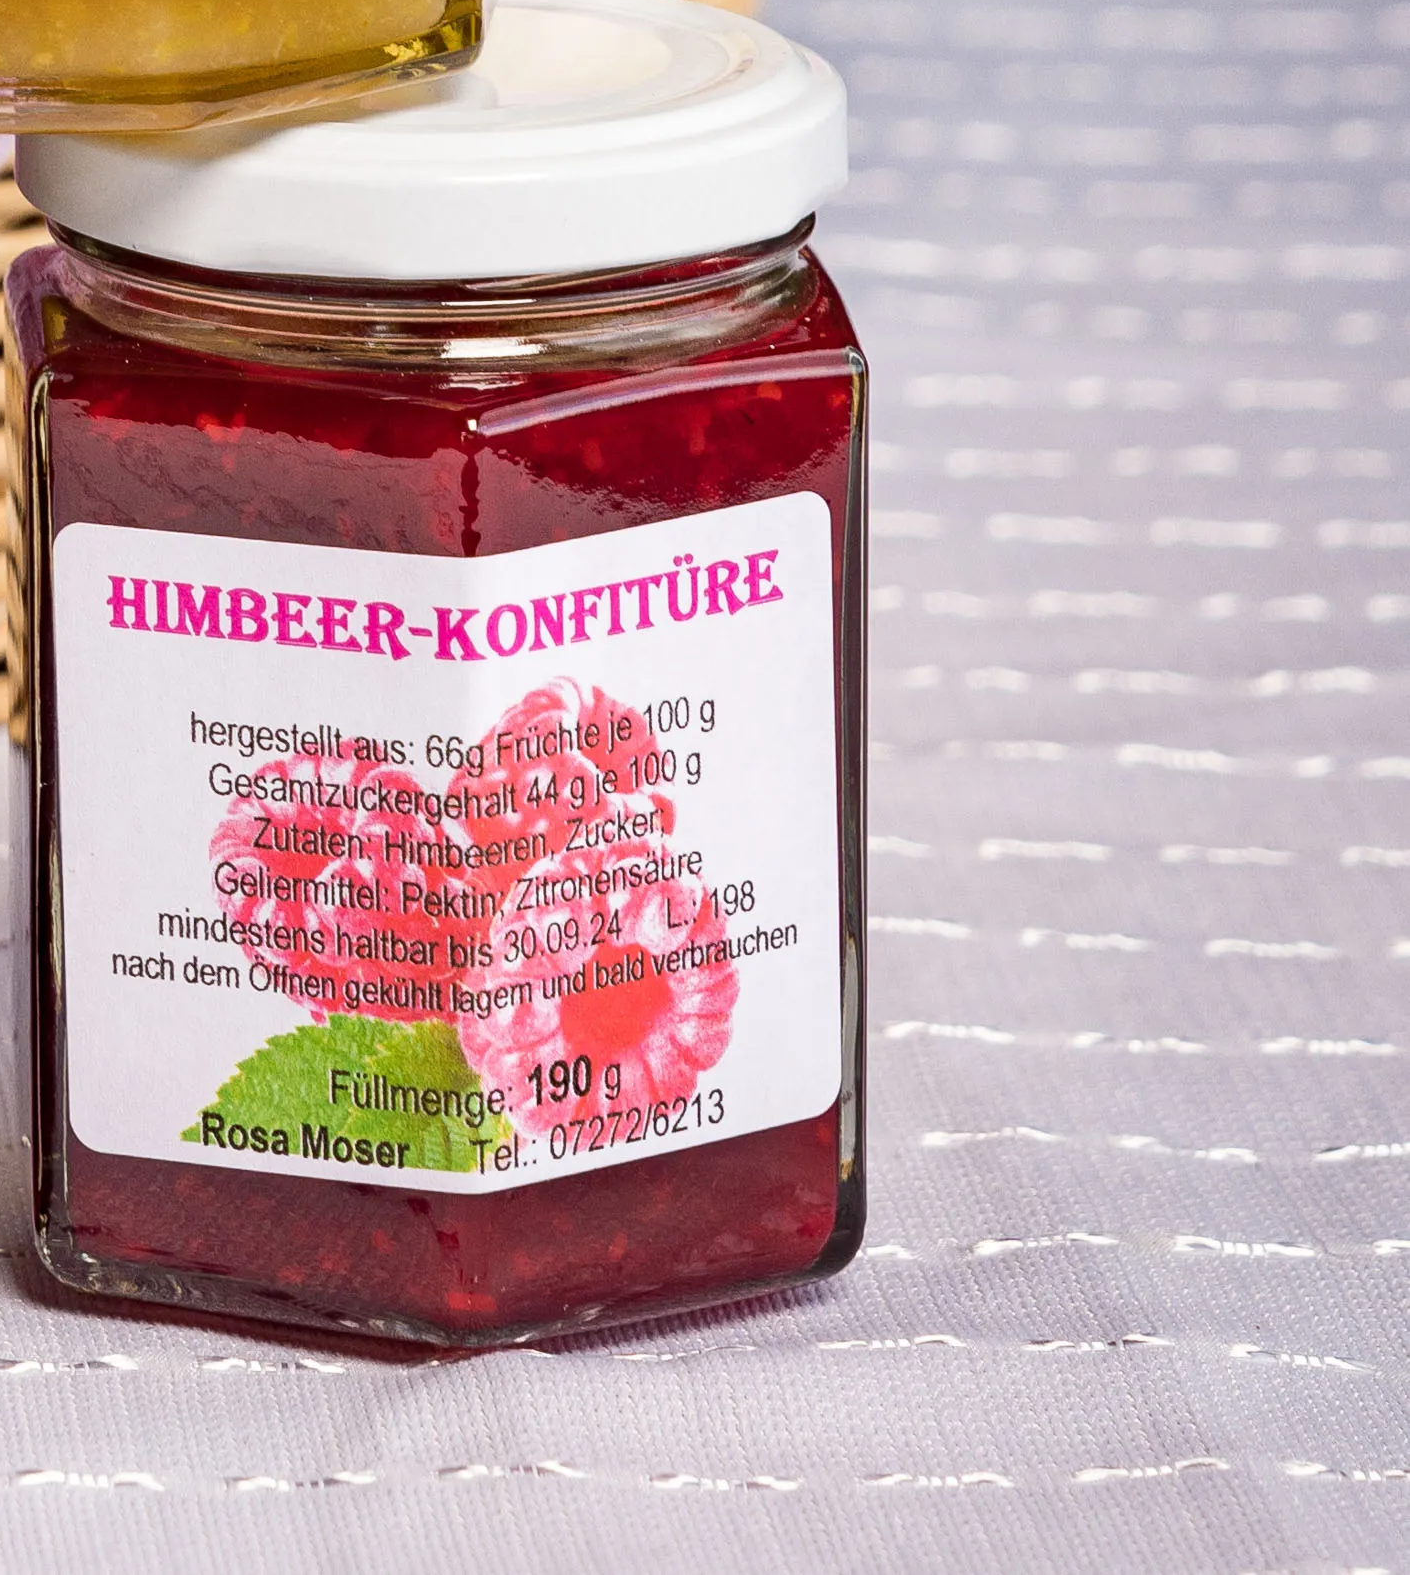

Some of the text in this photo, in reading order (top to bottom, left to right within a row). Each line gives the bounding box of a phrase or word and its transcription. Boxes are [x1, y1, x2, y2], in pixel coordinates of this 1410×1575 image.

[105, 546, 786, 663] HIMBEER-KONFITÜRE
[213, 844, 703, 922] Geliermittel: Pektin; Zitronensäure
[252, 816, 373, 861] Zutaten:
[384, 829, 555, 870] Himbeeren,
[158, 907, 326, 956] mindestens
[335, 922, 441, 967] haltbar
[449, 934, 494, 971] bis
[499, 908, 623, 963] 30.09.24
[709, 879, 756, 920] 198
[201, 1088, 725, 1172] Rosa Moser Tel.: 07272/6213
[330, 1054, 621, 1127] Füllmenge: 190 g
